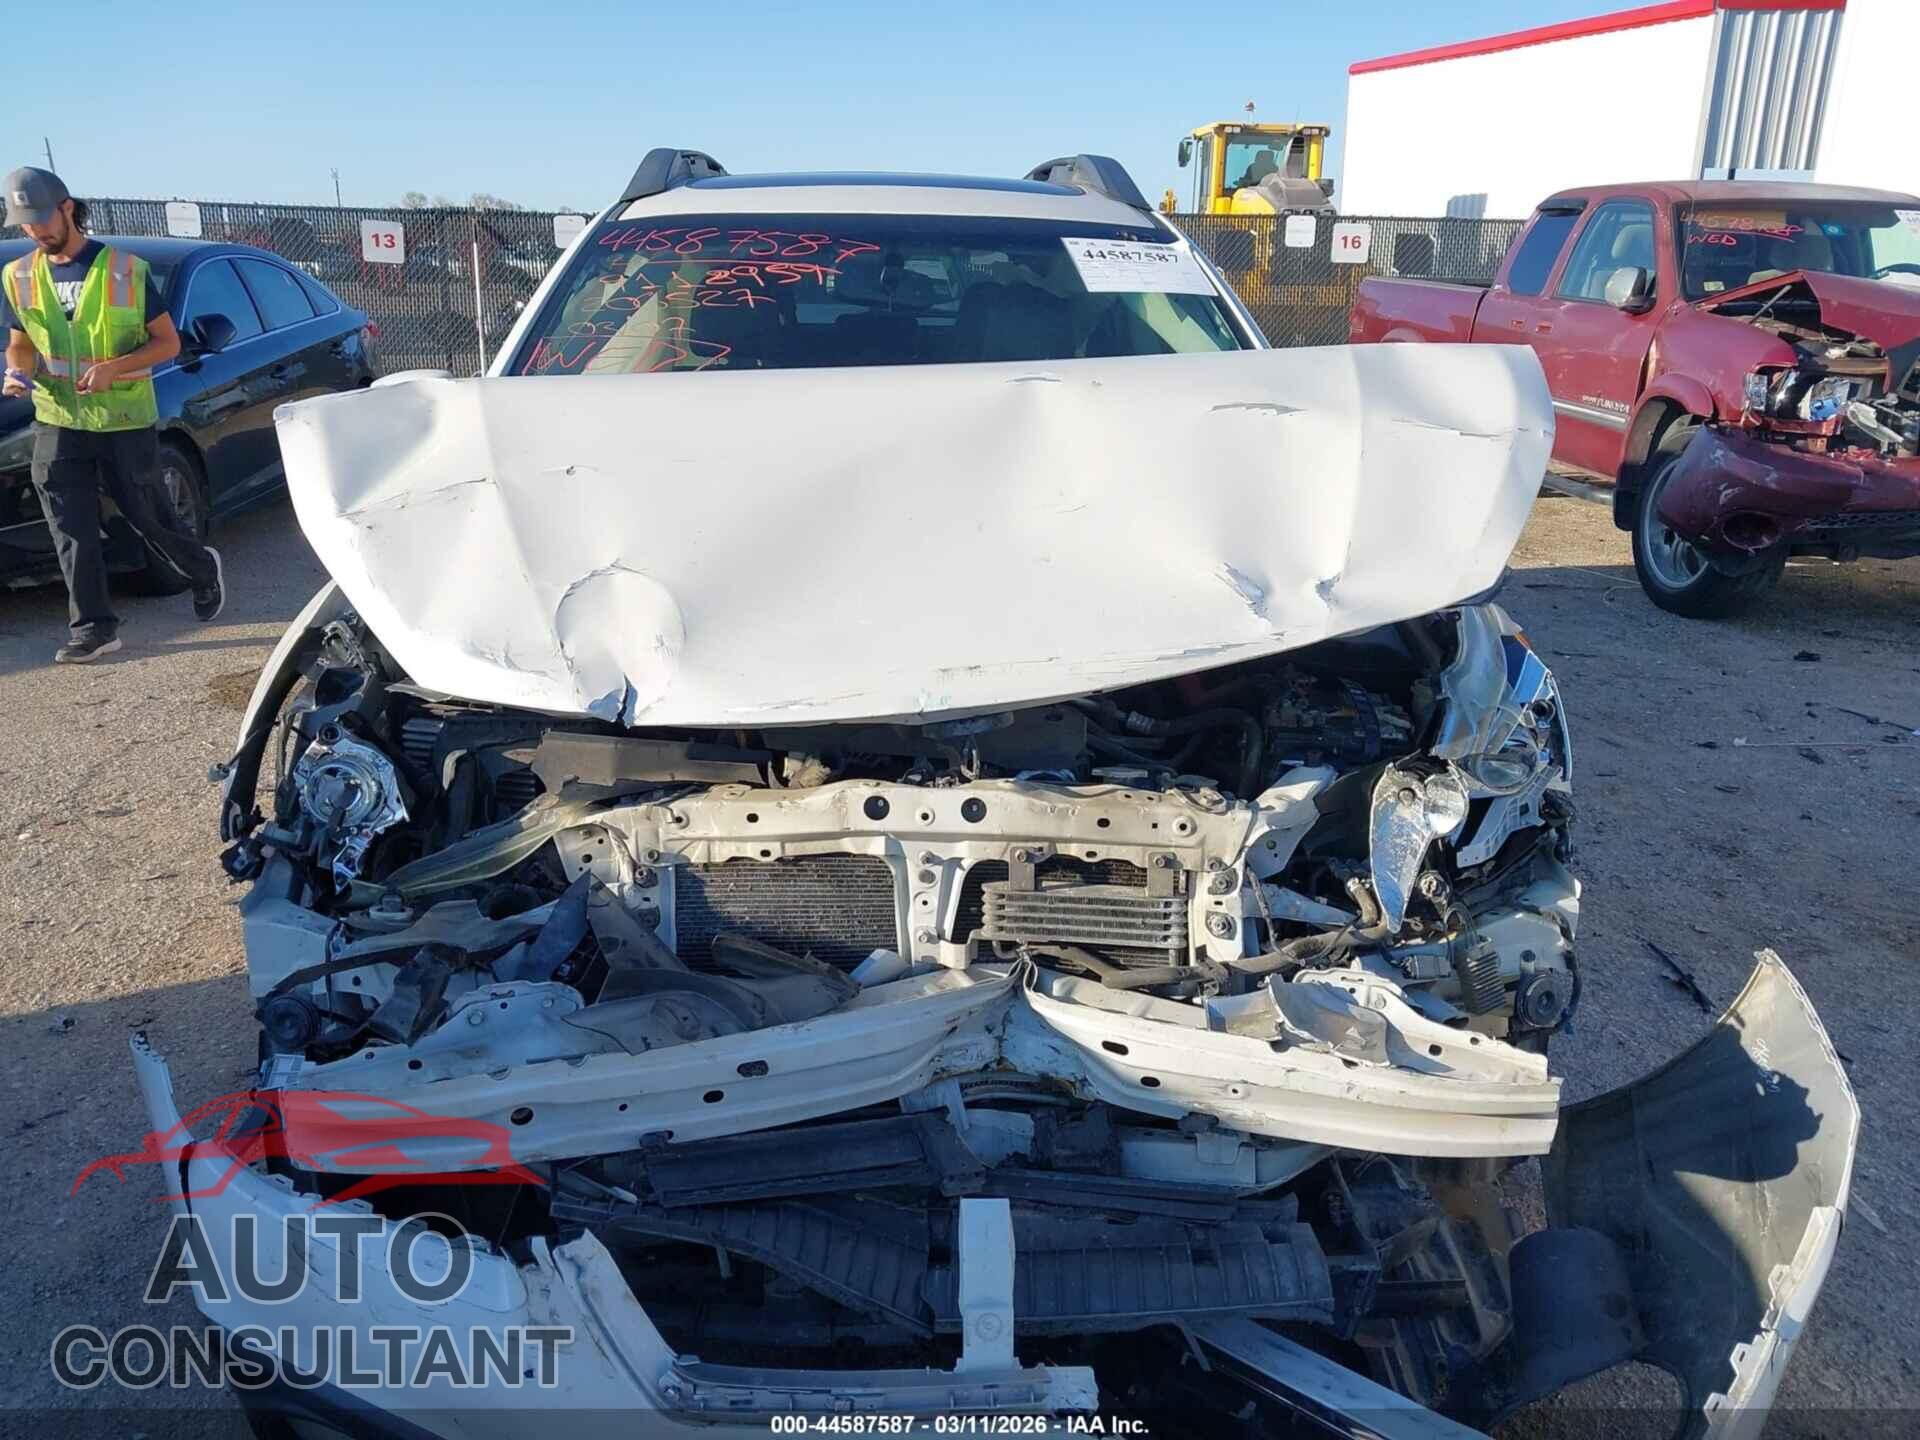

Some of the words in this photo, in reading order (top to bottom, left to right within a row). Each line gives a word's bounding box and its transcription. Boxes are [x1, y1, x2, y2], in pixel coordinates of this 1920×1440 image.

[371, 233, 396, 249] 13
[1341, 235, 1362, 249] 16
[1083, 249, 1178, 263] 44587587
